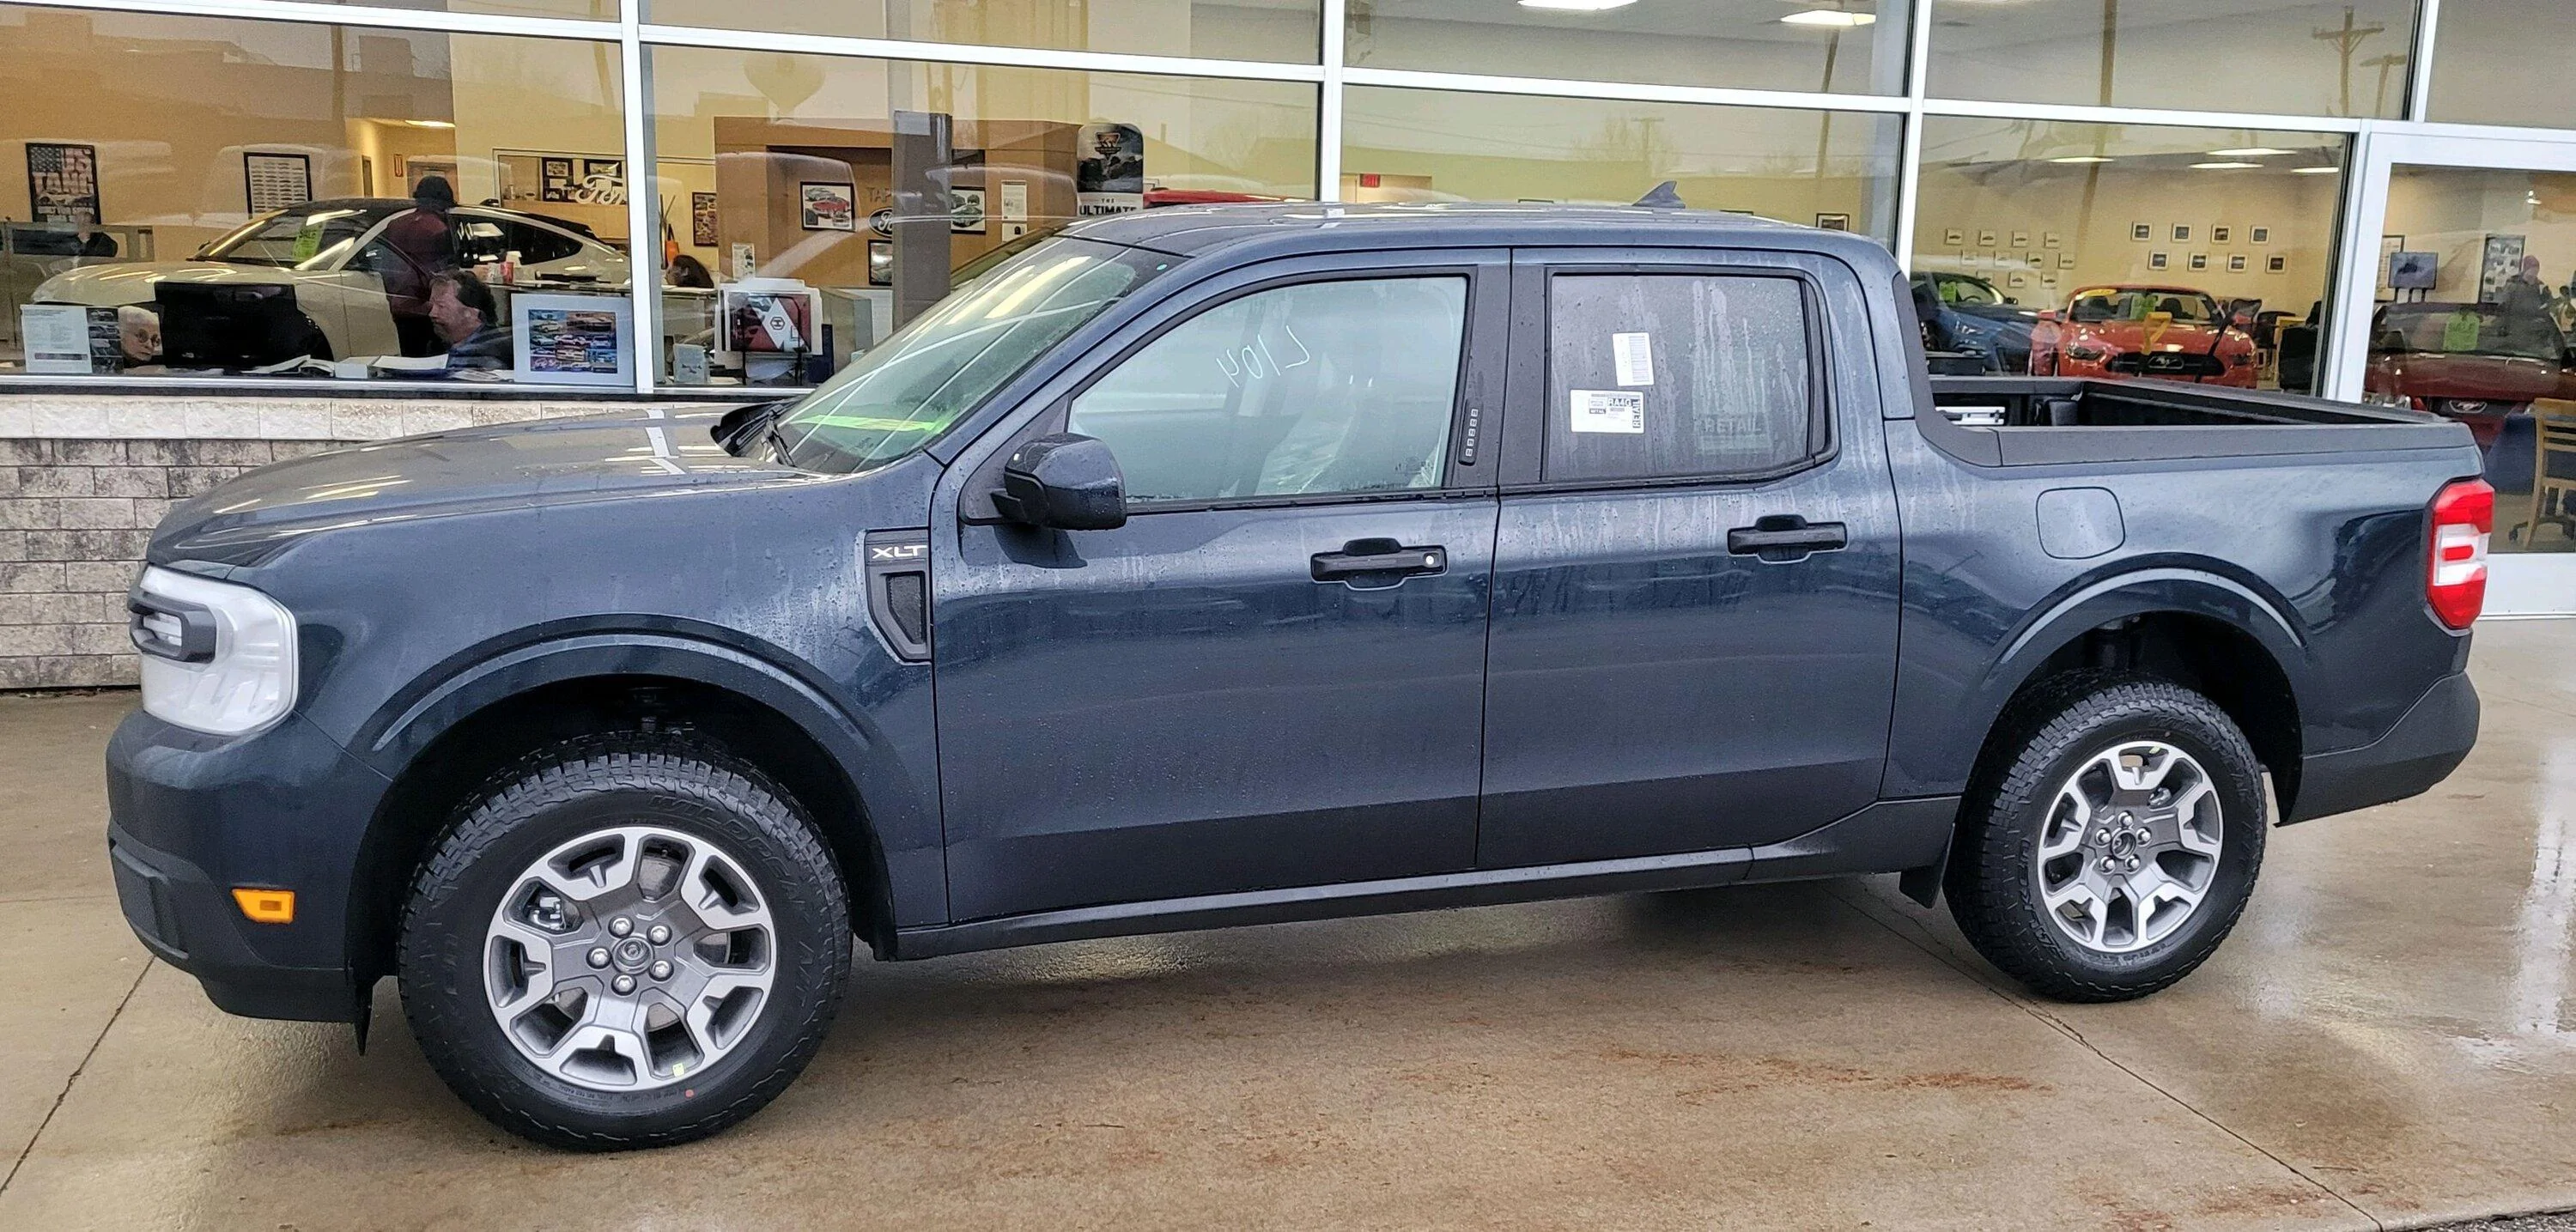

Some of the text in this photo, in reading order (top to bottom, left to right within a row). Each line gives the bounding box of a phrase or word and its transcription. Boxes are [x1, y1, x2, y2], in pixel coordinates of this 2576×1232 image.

[1079, 204, 1137, 215] ULTIMAT
[1632, 399, 1641, 428] RETAIL
[1704, 416, 1761, 433] RETAIL
[872, 544, 928, 559] XLT
